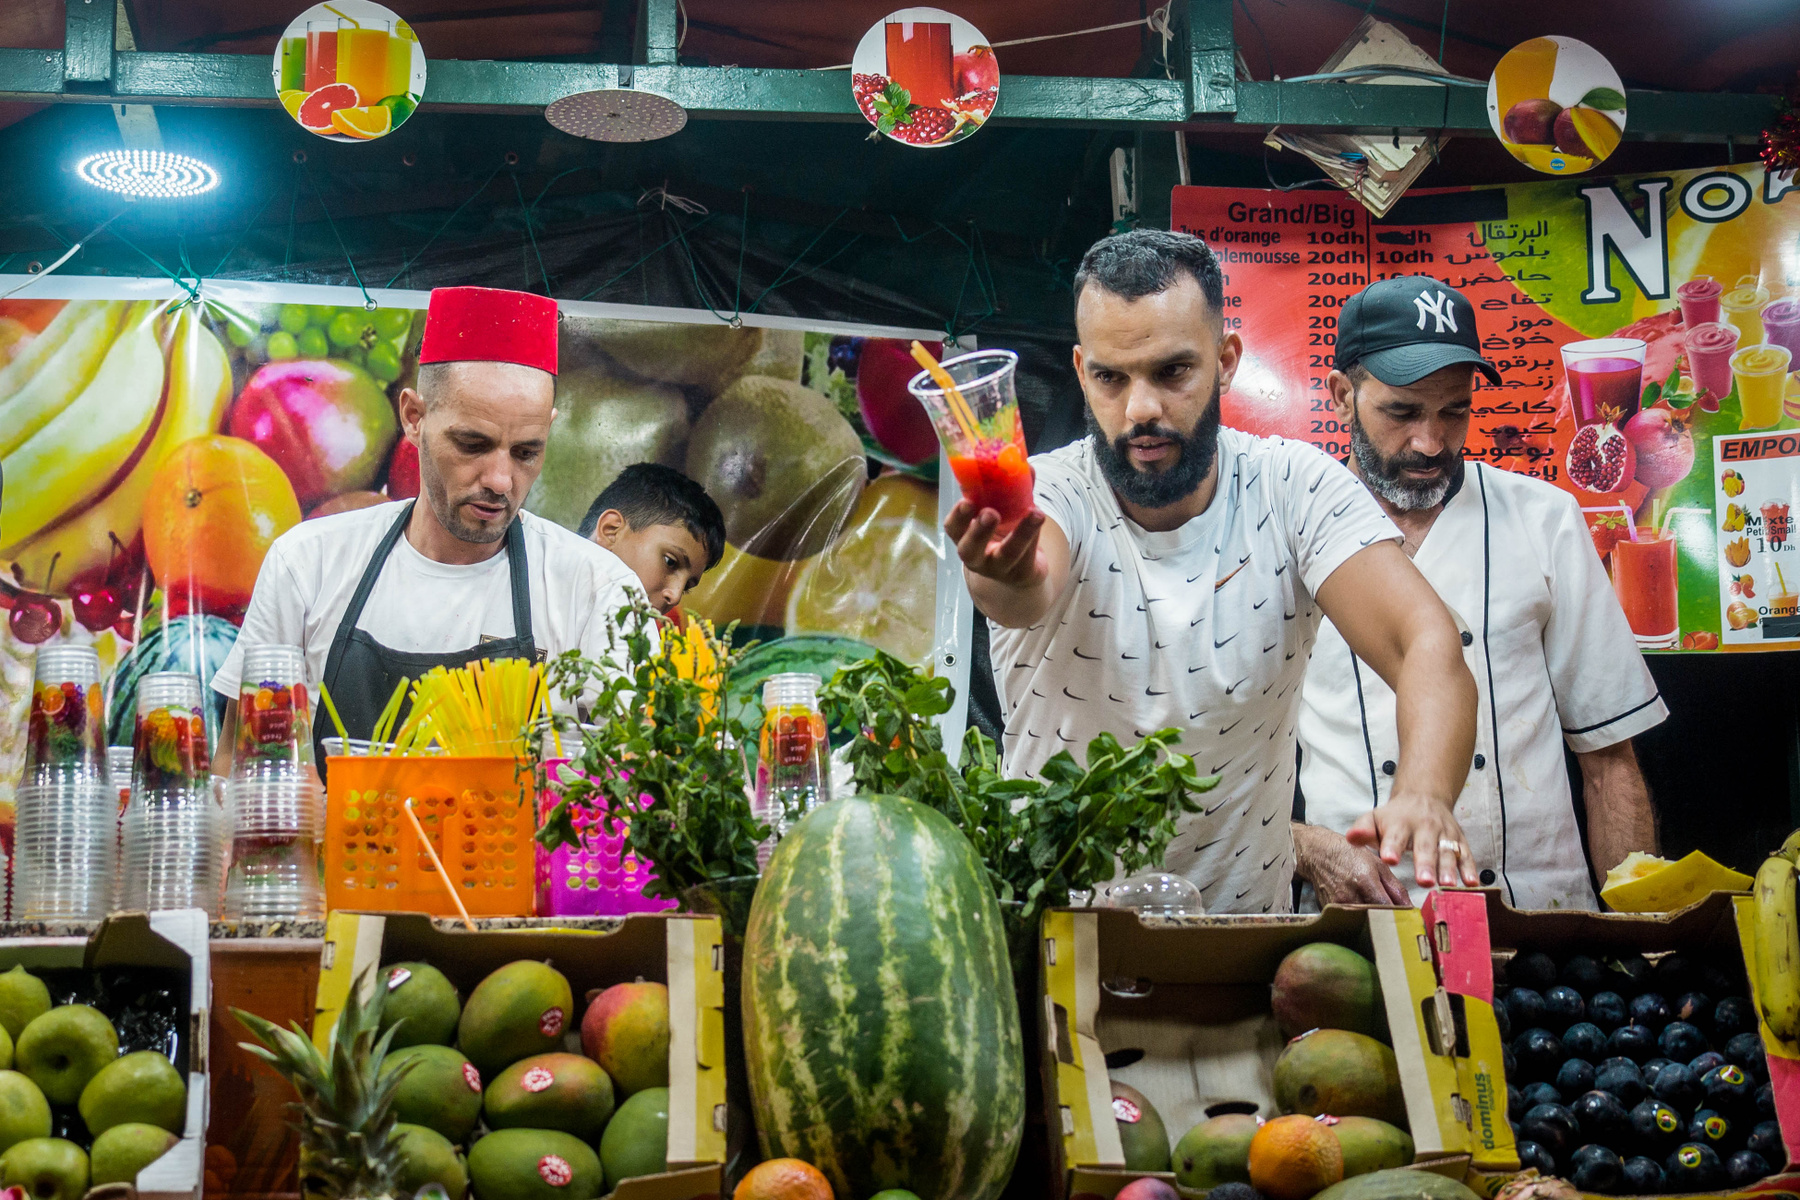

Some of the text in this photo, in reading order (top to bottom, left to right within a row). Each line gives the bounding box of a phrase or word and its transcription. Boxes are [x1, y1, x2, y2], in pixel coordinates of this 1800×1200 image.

[1228, 201, 1355, 229] Grand/Big
[1210, 226, 1281, 247] d'orange
[1307, 231, 1365, 245] 10dh
[1466, 220, 1549, 248] البرتقال
[1307, 251, 1366, 264] 20dh
[1375, 250, 1434, 264] 10dh
[1307, 272, 1366, 286] 20dh
[1308, 294, 1351, 308] 20d
[1480, 293, 1554, 311] تفاح
[1413, 290, 1458, 333] NY
[1506, 315, 1554, 333] موز
[1482, 331, 1554, 350] خوخ
[1722, 437, 1800, 460] EMPO
[1756, 536, 1783, 553] 10
[1475, 1073, 1495, 1150] dominus
